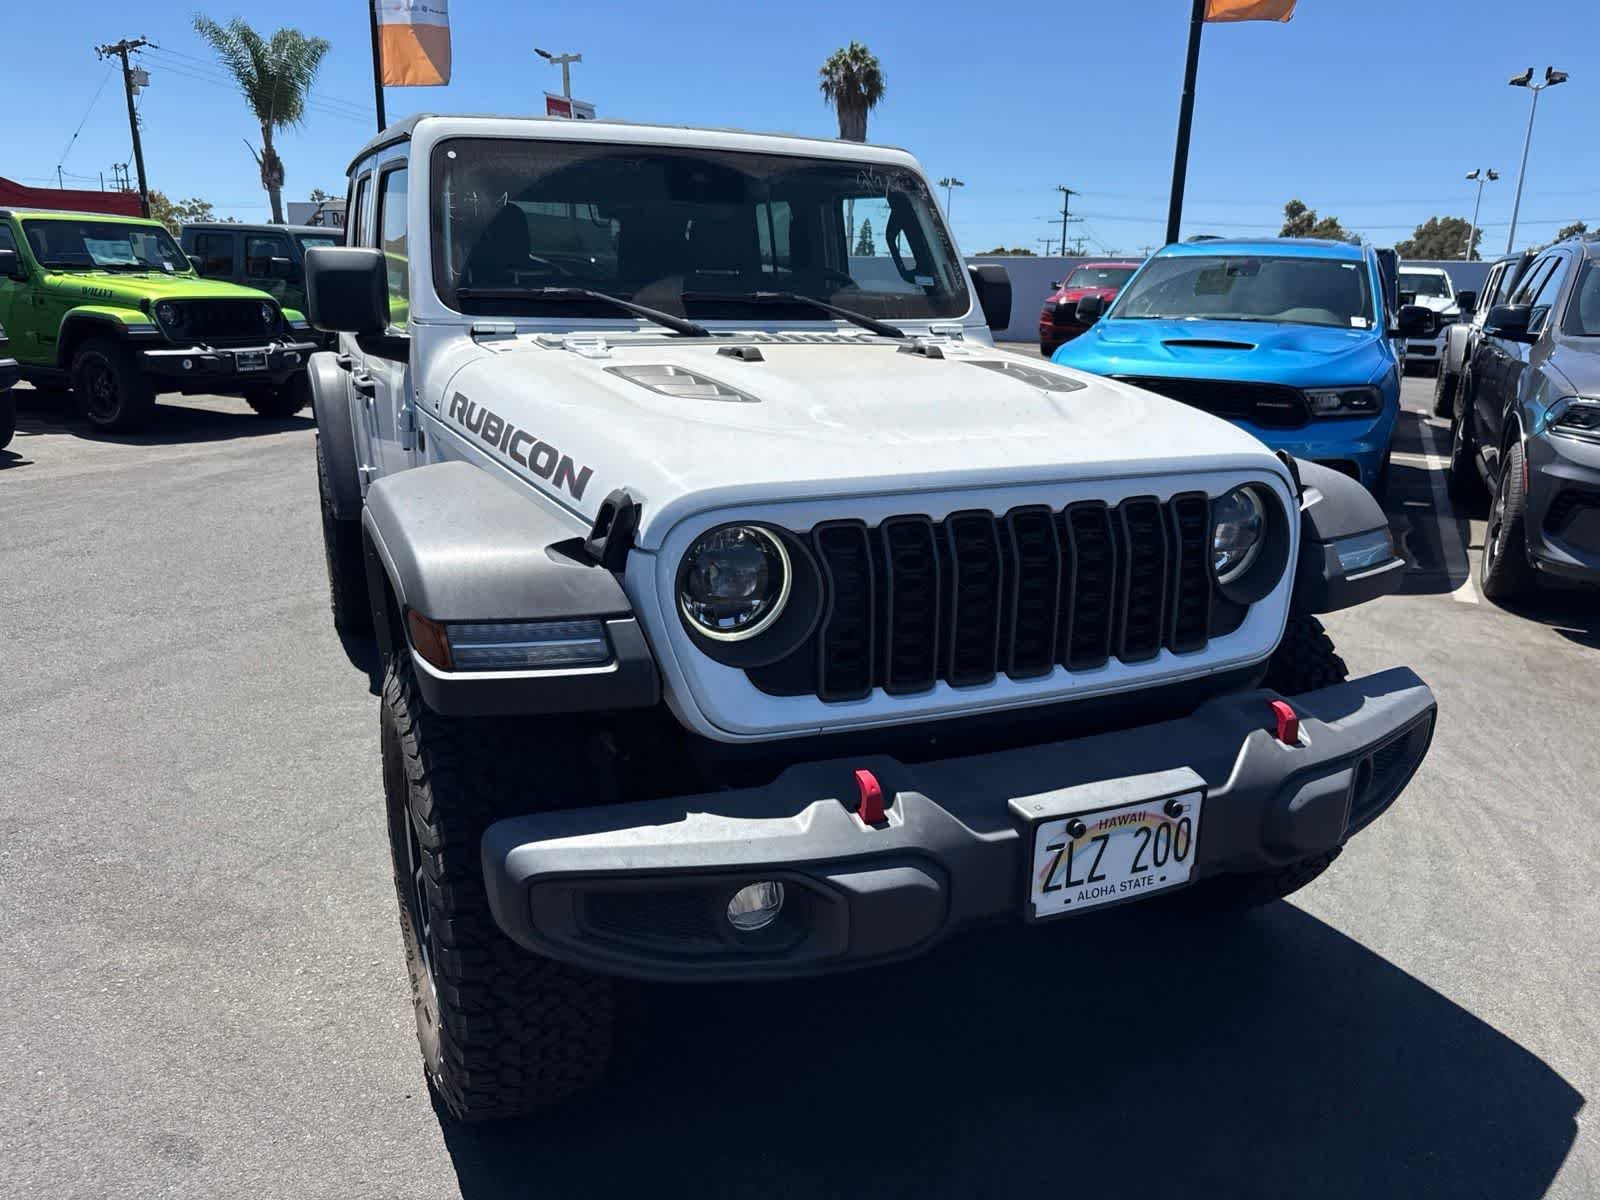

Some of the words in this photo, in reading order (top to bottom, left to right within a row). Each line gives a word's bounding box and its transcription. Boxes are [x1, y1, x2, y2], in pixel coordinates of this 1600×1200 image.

[449, 391, 594, 502] RUBICON
[1099, 811, 1146, 830] HAWAII
[1042, 834, 1110, 894] ZLZ
[1130, 817, 1192, 874] 200
[1077, 885, 1116, 901] ALOHA
[1120, 875, 1155, 892] STATE
